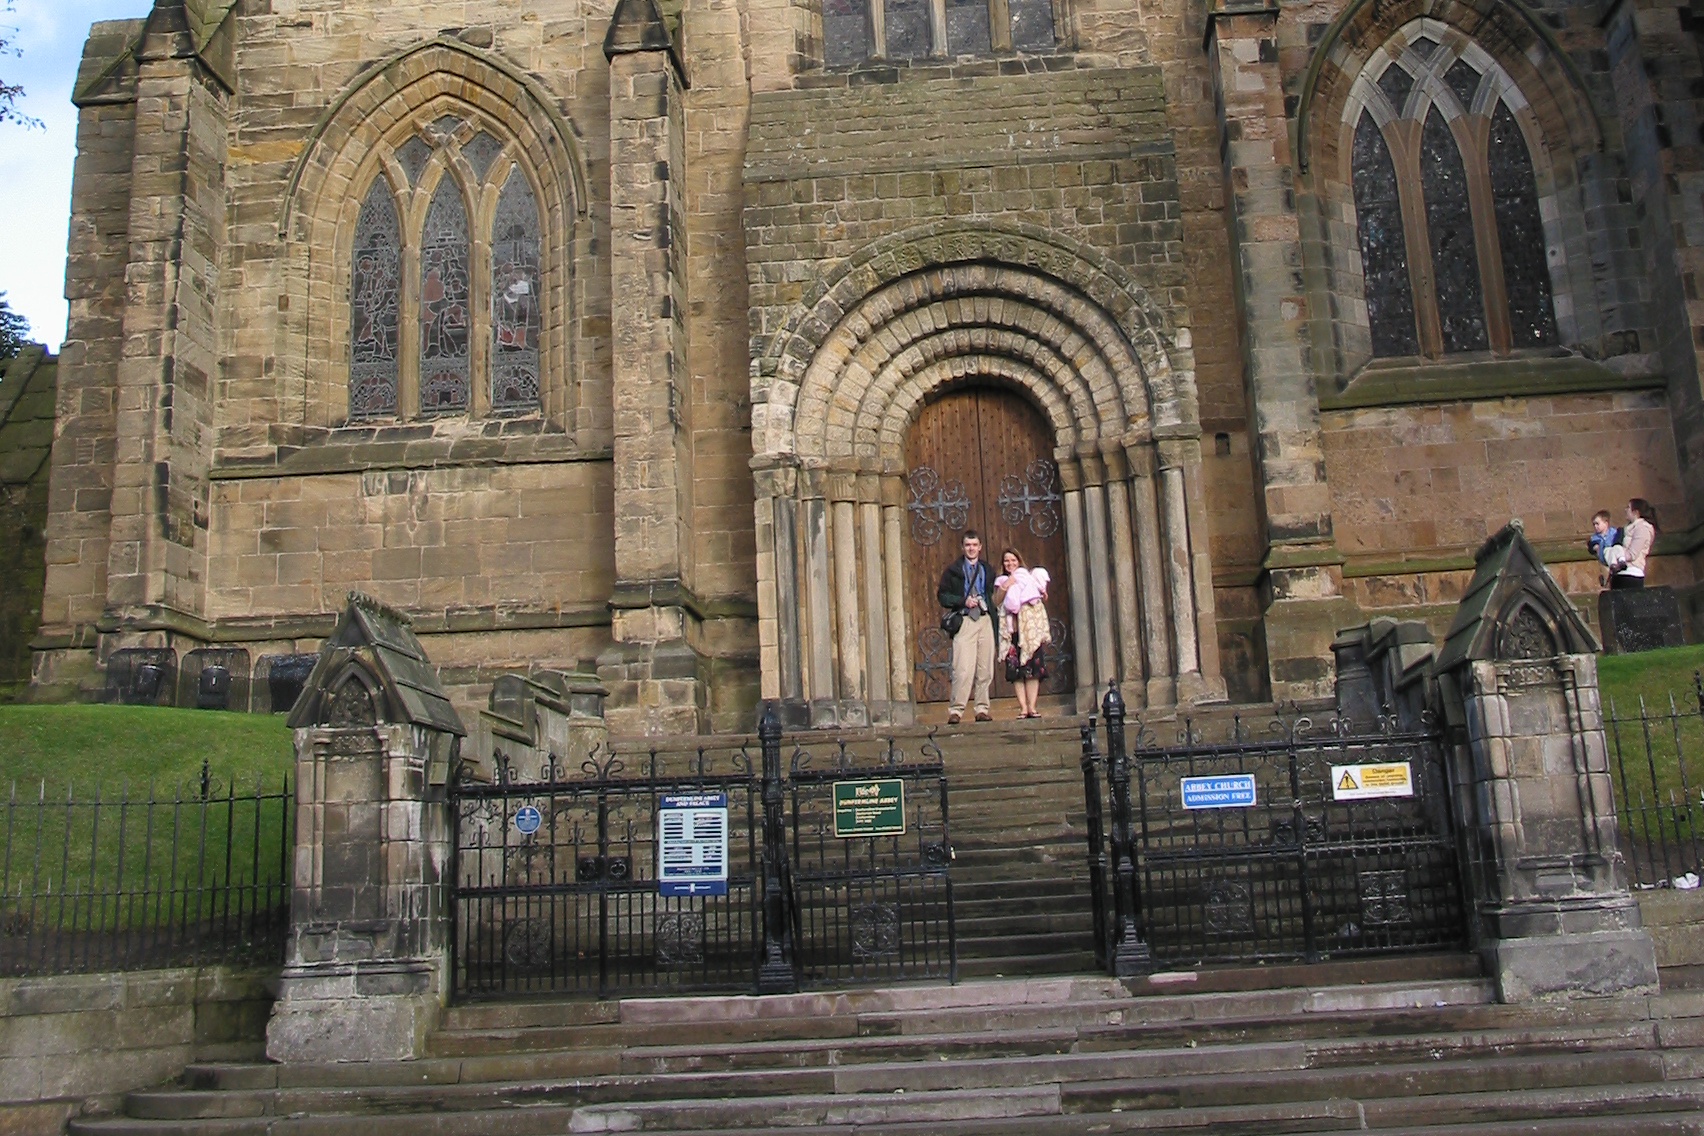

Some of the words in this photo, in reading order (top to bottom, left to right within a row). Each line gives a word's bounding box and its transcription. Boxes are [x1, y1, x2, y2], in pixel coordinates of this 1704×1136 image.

[1185, 783, 1212, 791] ABBEY
[1215, 780, 1251, 789] CHURCH
[1187, 794, 1229, 802] ADMISSION
